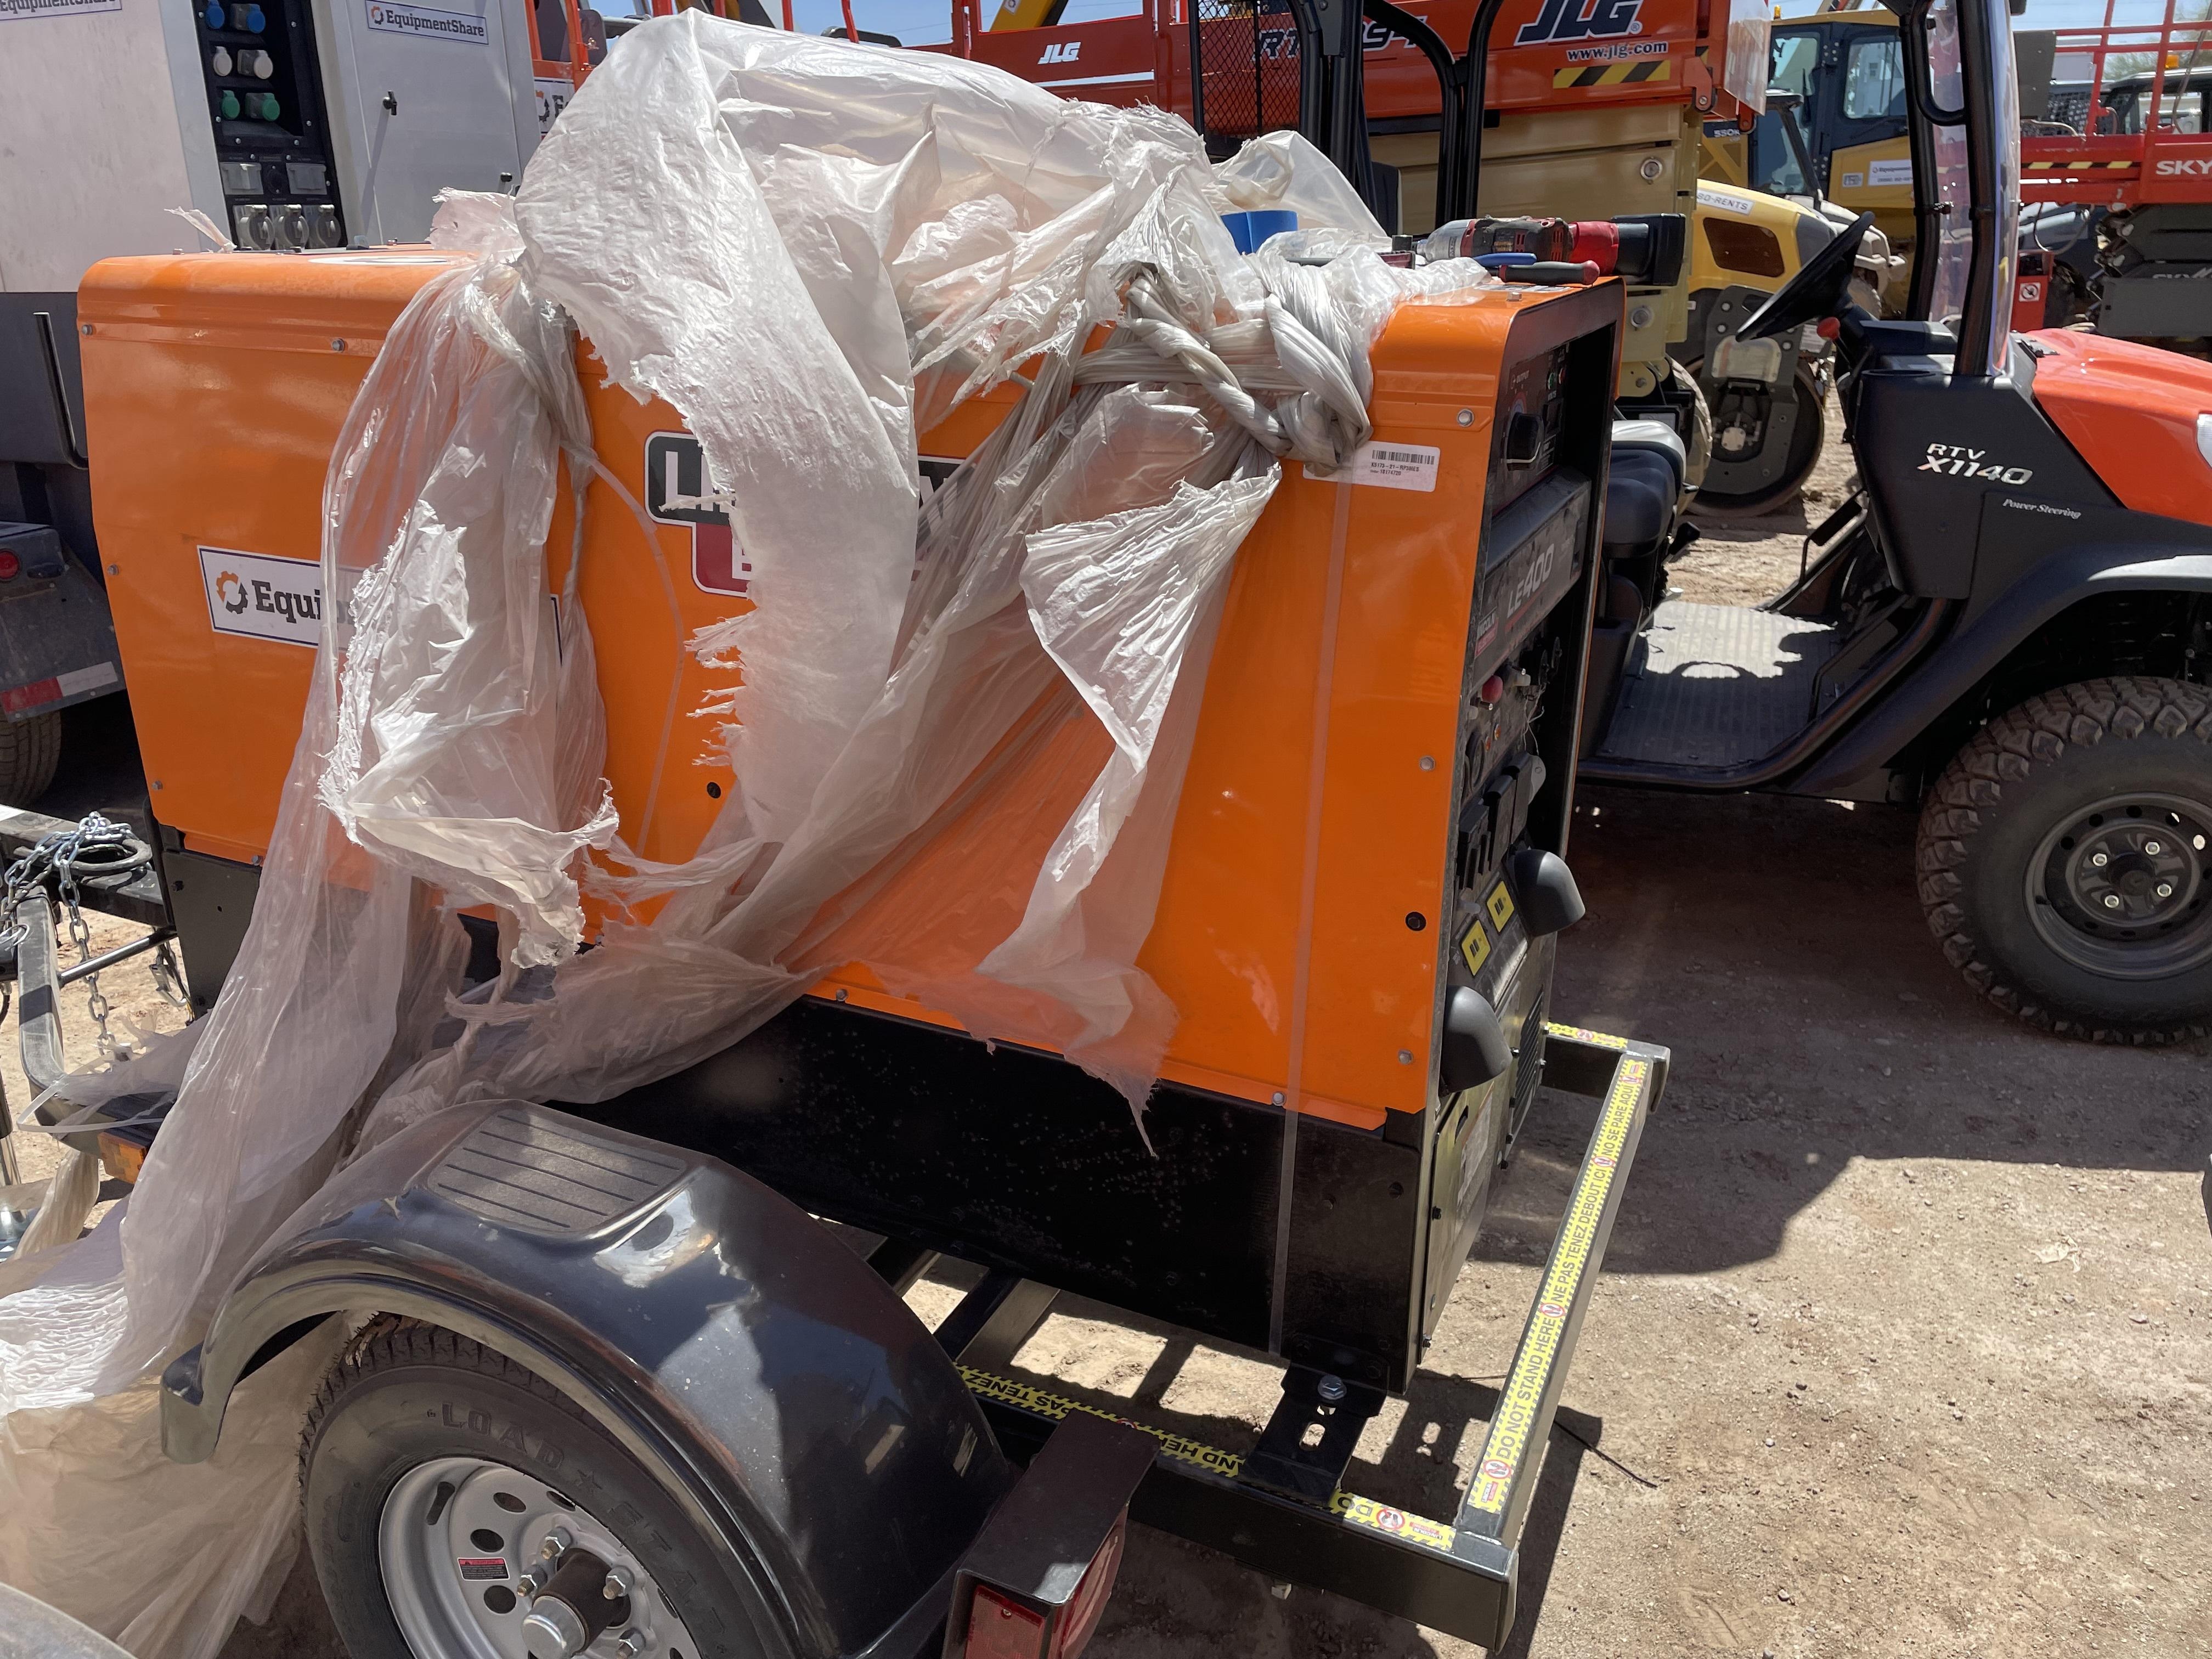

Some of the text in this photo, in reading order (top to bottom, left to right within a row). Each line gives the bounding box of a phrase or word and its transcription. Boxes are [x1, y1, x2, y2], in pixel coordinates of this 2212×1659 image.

[385, 9, 484, 37] EquipmentShare
[1514, 0, 1644, 46] JLG
[1037, 41, 1081, 65] JLG
[1566, 41, 1669, 61] www.jlg.com
[1926, 442, 1986, 460] RTV
[1917, 455, 2034, 485] X1140
[2002, 498, 2082, 520] Power Steering
[1507, 543, 1555, 619] LE400
[1612, 1105, 1627, 1128] PARE
[1606, 1128, 1620, 1142] SE
[1601, 1141, 1615, 1156] NO
[1551, 1168, 1607, 1303] NE PAS TENEZ DEBOUT ICI
[965, 1373, 1030, 1402] TENEZ
[1496, 1317, 1556, 1460] DO NOT STAND HERE
[441, 1402, 565, 1469] LOAD
[1337, 1497, 1372, 1516] DO
